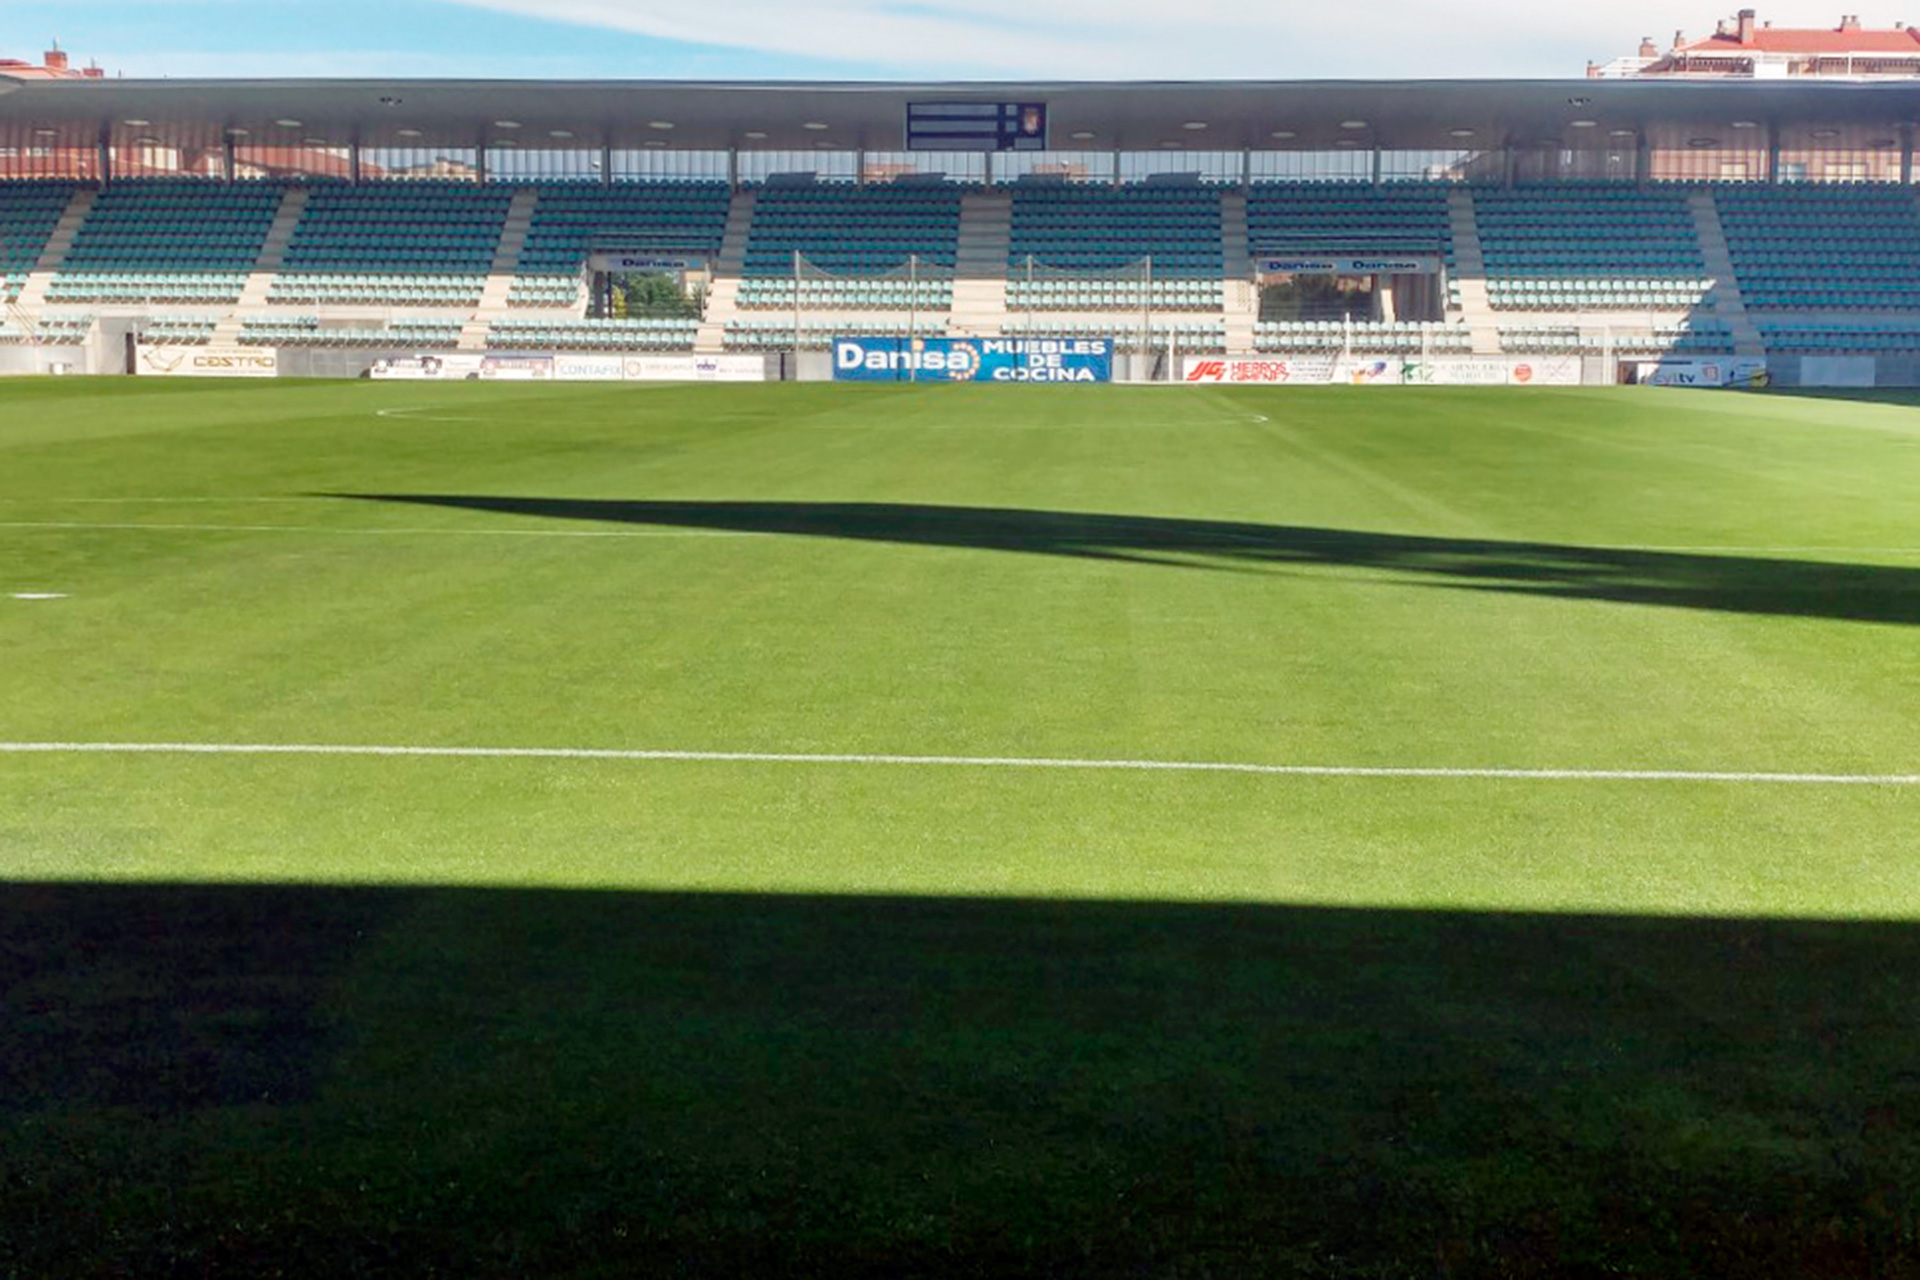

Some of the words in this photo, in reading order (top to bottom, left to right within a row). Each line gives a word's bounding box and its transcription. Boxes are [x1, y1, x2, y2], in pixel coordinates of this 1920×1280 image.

[983, 340, 1106, 354] MUEBLES
[837, 340, 970, 369] Danisa
[1029, 354, 1061, 367] DE
[560, 365, 622, 376] CONTAFIX
[1231, 361, 1287, 372] HIERROS
[993, 367, 1095, 381] COCINA
